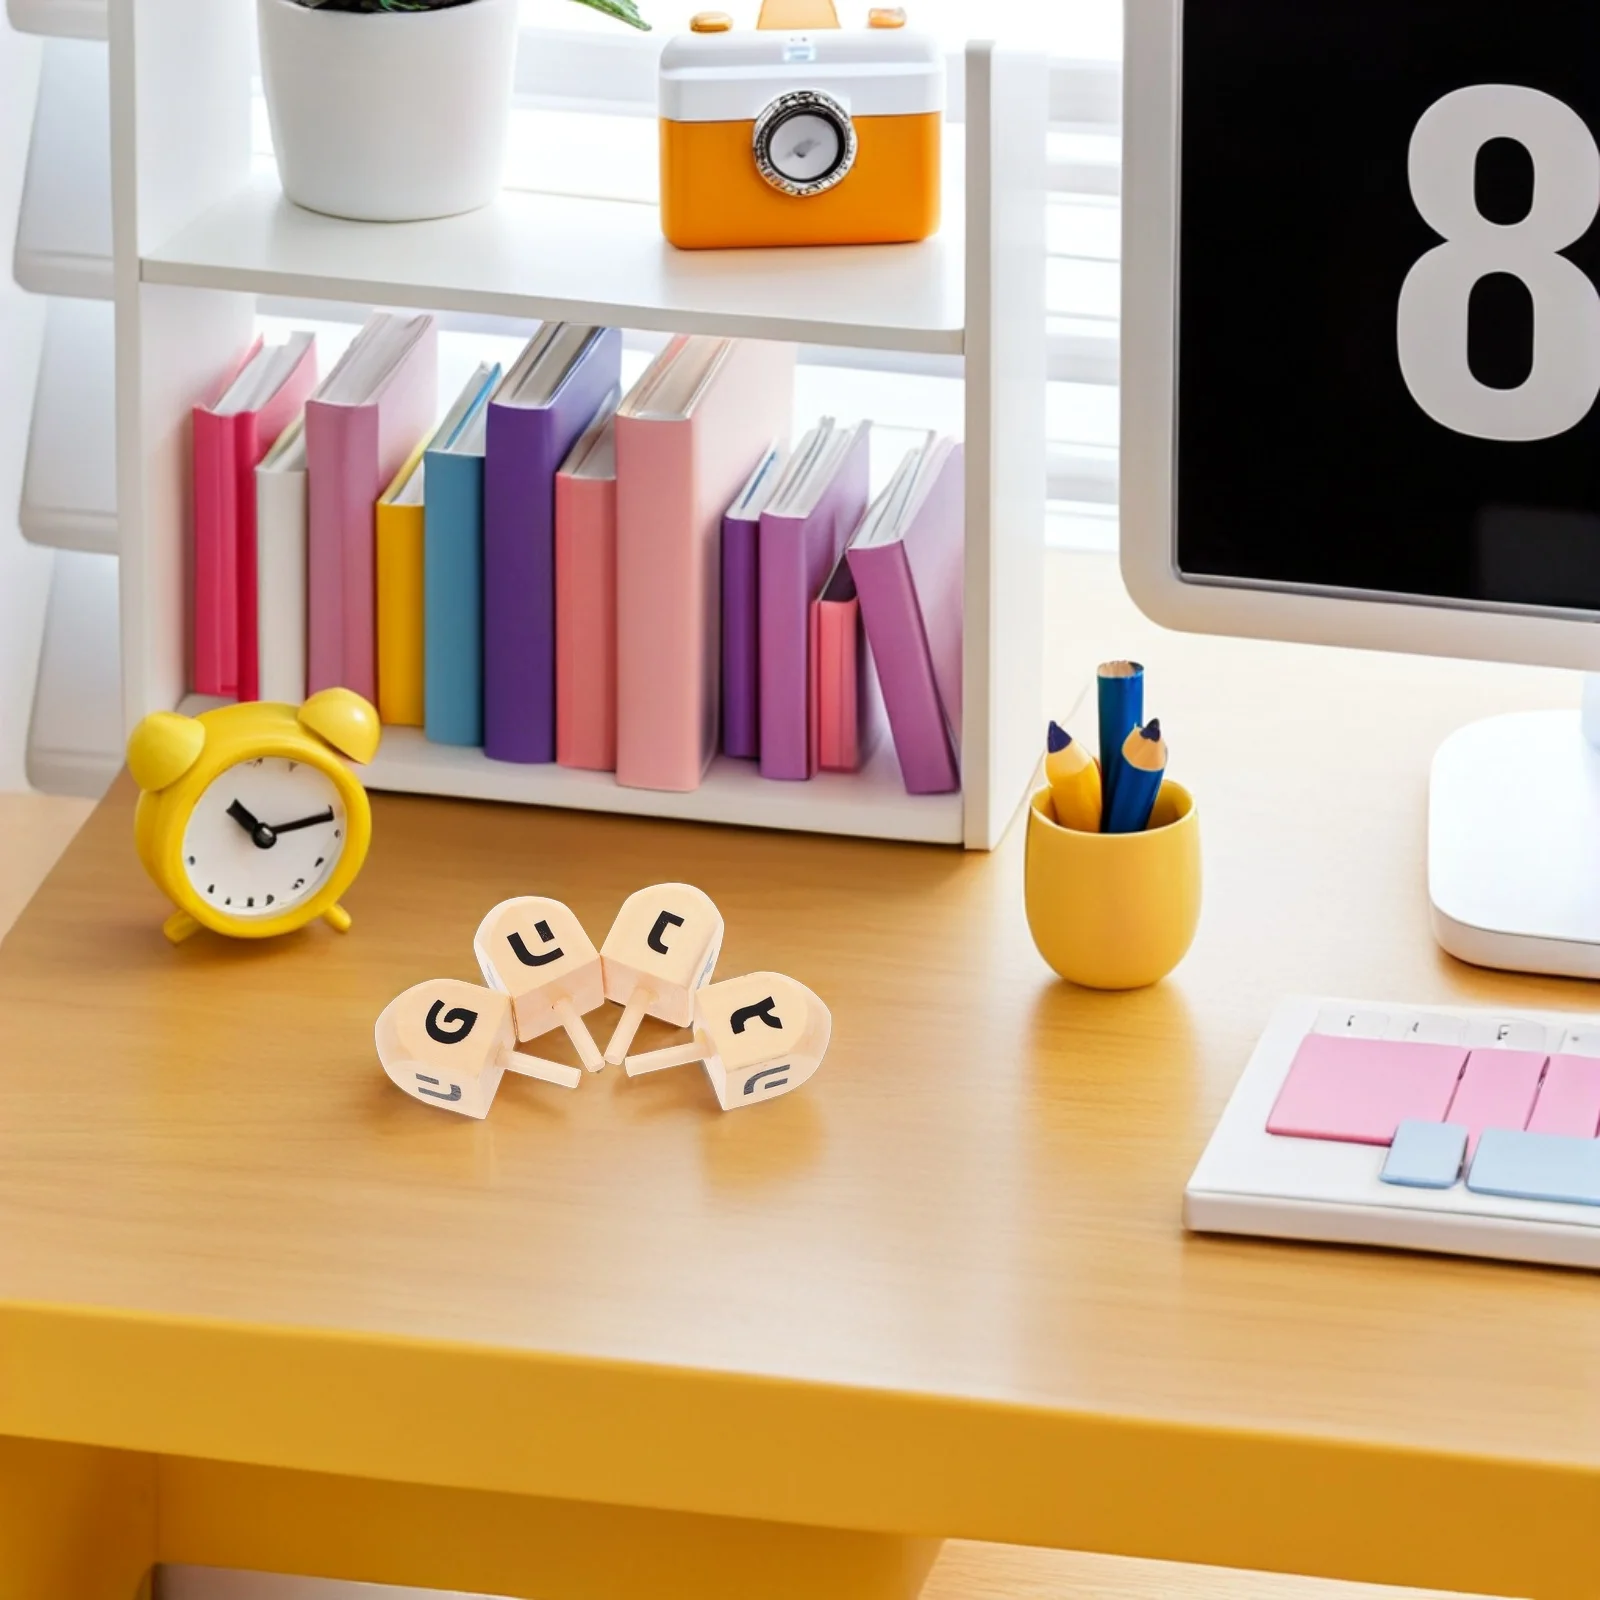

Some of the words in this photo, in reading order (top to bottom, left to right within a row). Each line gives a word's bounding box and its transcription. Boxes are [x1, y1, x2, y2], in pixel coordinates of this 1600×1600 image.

[1397, 83, 1600, 442] 8
[506, 919, 565, 967] ה
[425, 999, 479, 1045] פ
[730, 996, 783, 1035] ג
